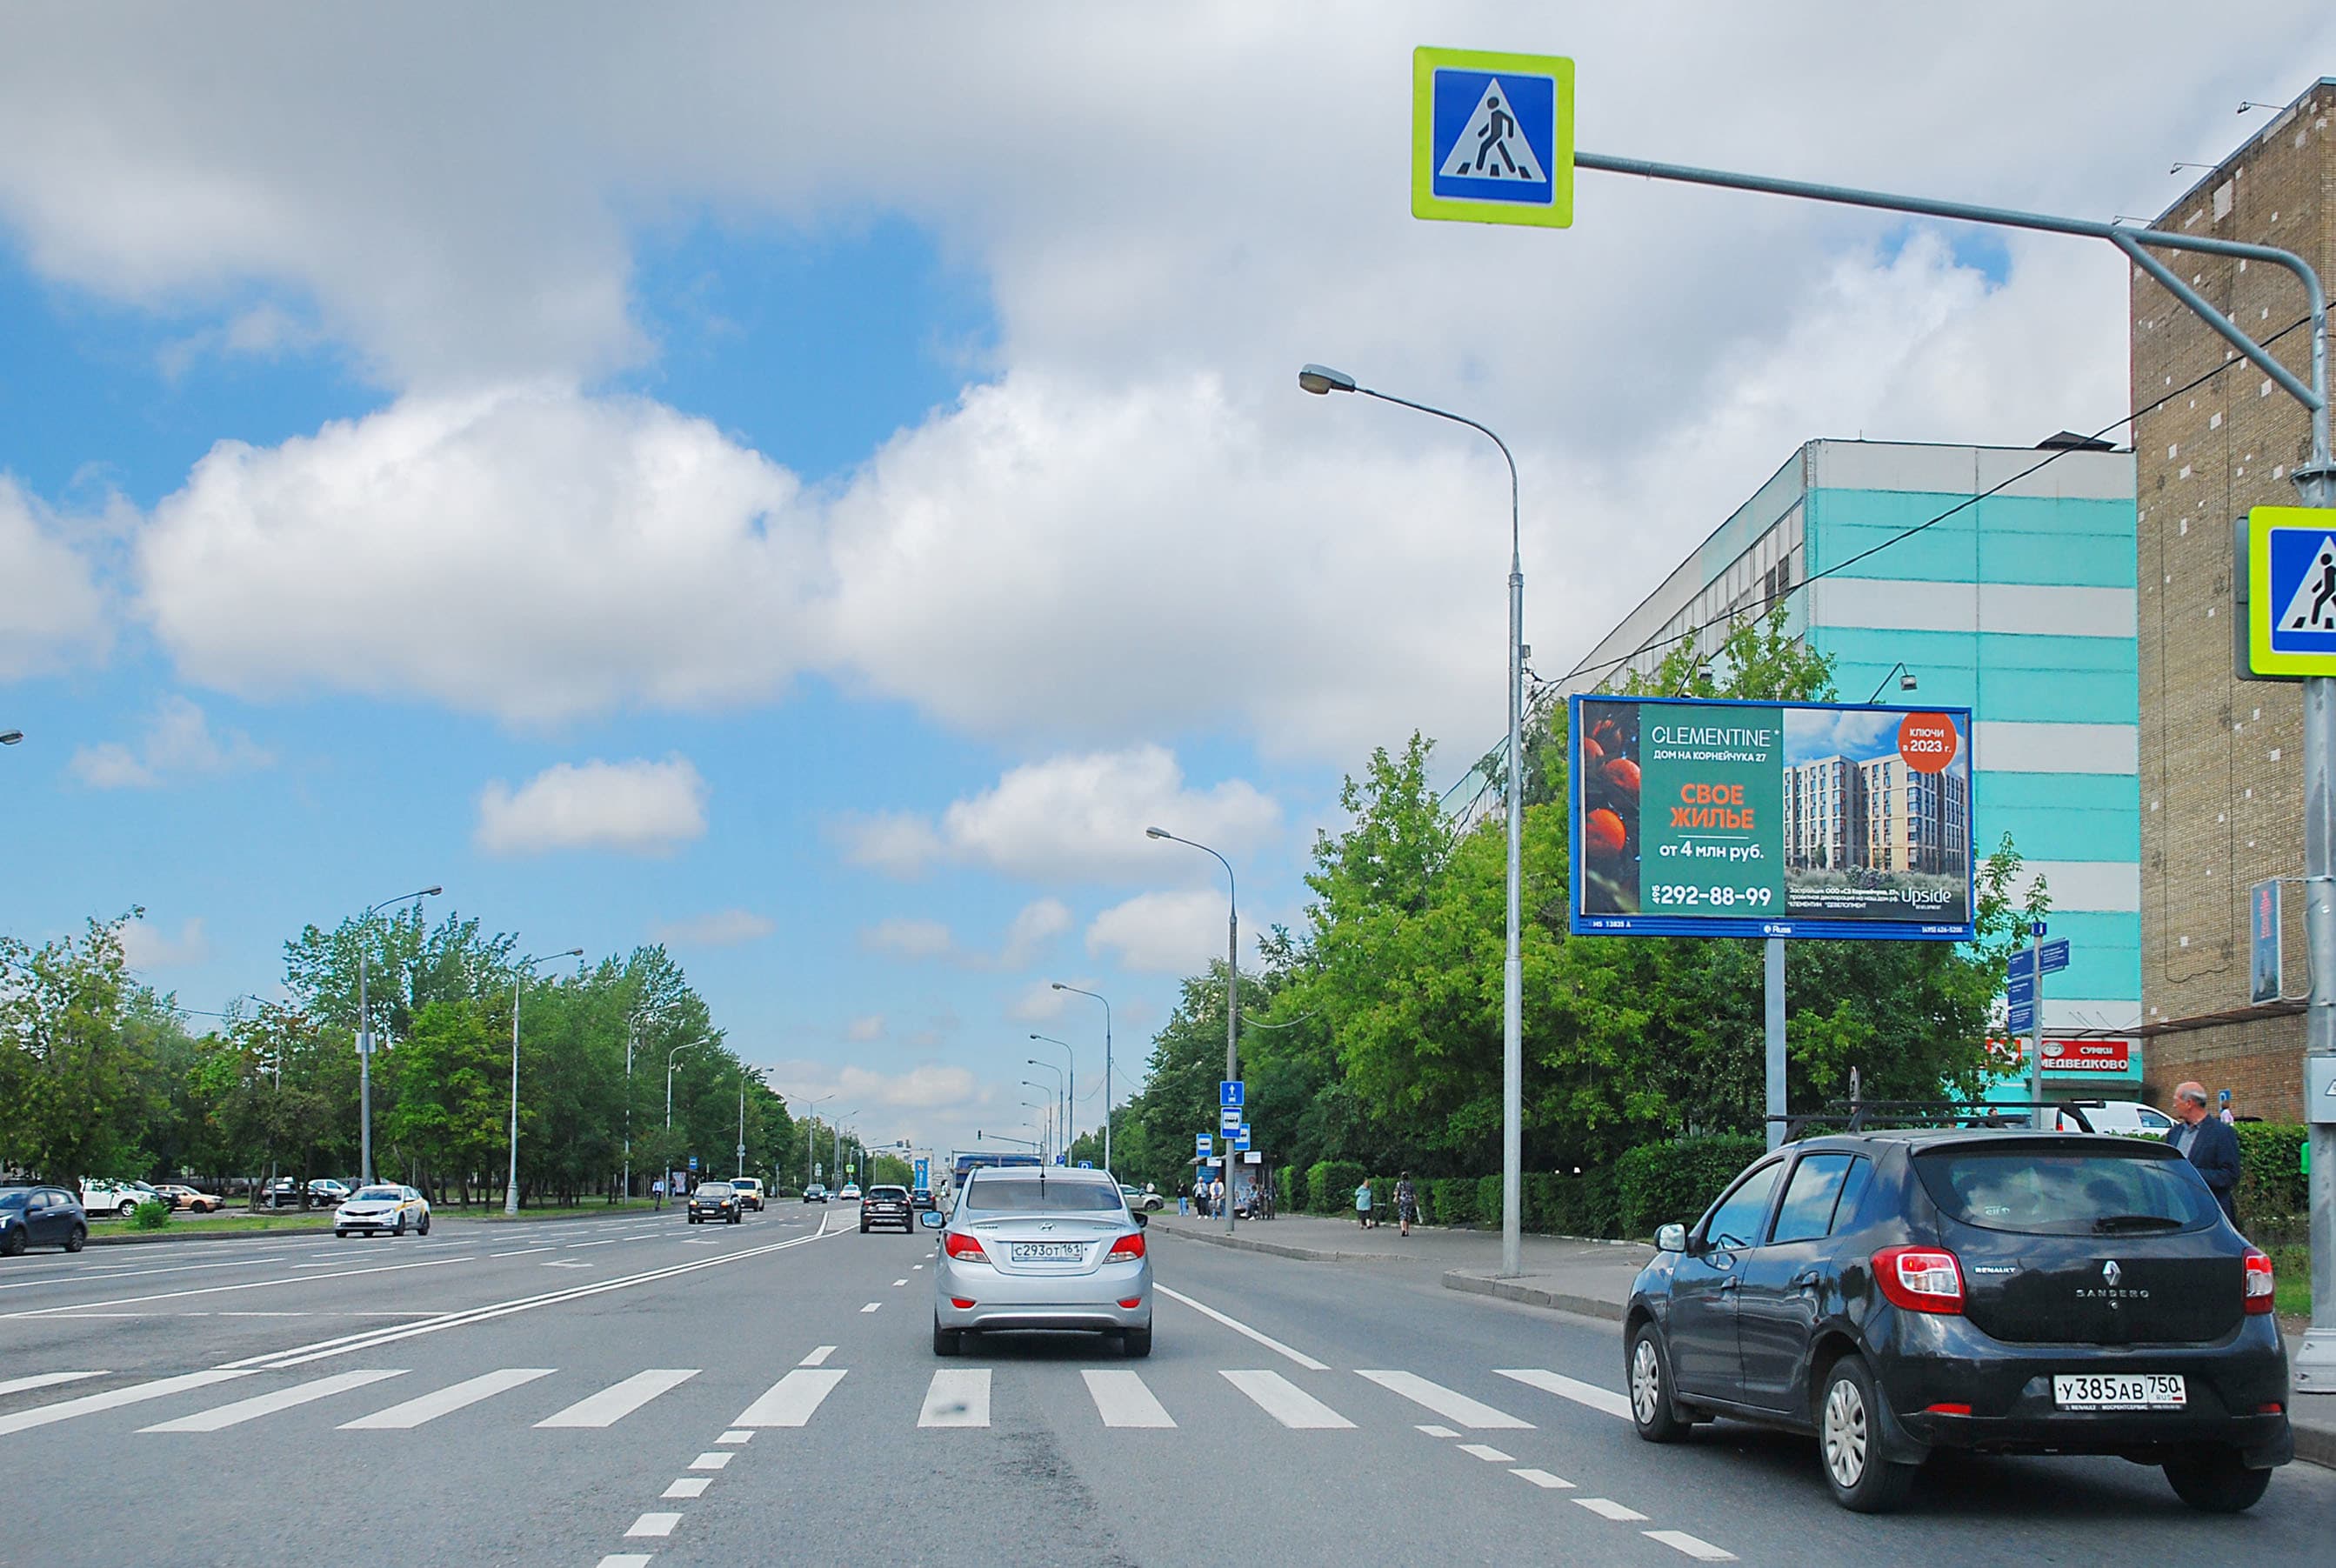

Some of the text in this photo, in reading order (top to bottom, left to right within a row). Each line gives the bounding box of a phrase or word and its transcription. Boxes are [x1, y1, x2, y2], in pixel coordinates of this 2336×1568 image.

[1909, 728, 1945, 737] КЛЮЧИ
[1910, 739, 1942, 752] 2023
[1653, 750, 1766, 763] ДОМ НА КОРНЕЙЧУКА 27
[1680, 783, 1745, 805] СВОЕ
[1670, 807, 1755, 830] ЖИЛЬЕ
[1659, 840, 1765, 862] от 4 млн руб.
[1660, 884, 1772, 907] 292-88-99
[1901, 887, 1952, 906] Upside
[2076, 1289, 2150, 1298] SANDERO
[2062, 1377, 2179, 1400] У385АВ 750
